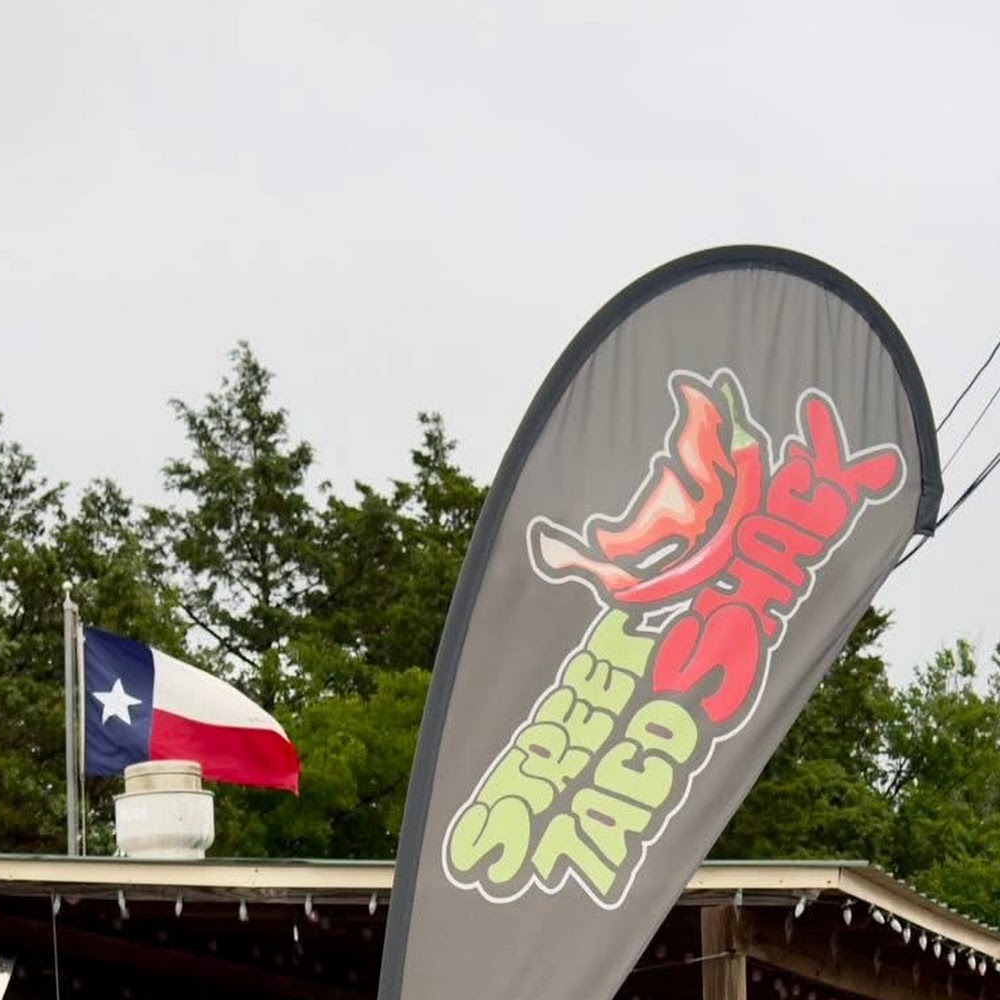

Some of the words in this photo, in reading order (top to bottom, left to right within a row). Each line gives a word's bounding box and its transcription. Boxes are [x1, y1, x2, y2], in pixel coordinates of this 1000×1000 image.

[448, 608, 656, 884] STREET
[531, 699, 699, 897] TACO
[652, 395, 899, 723] SHACK
